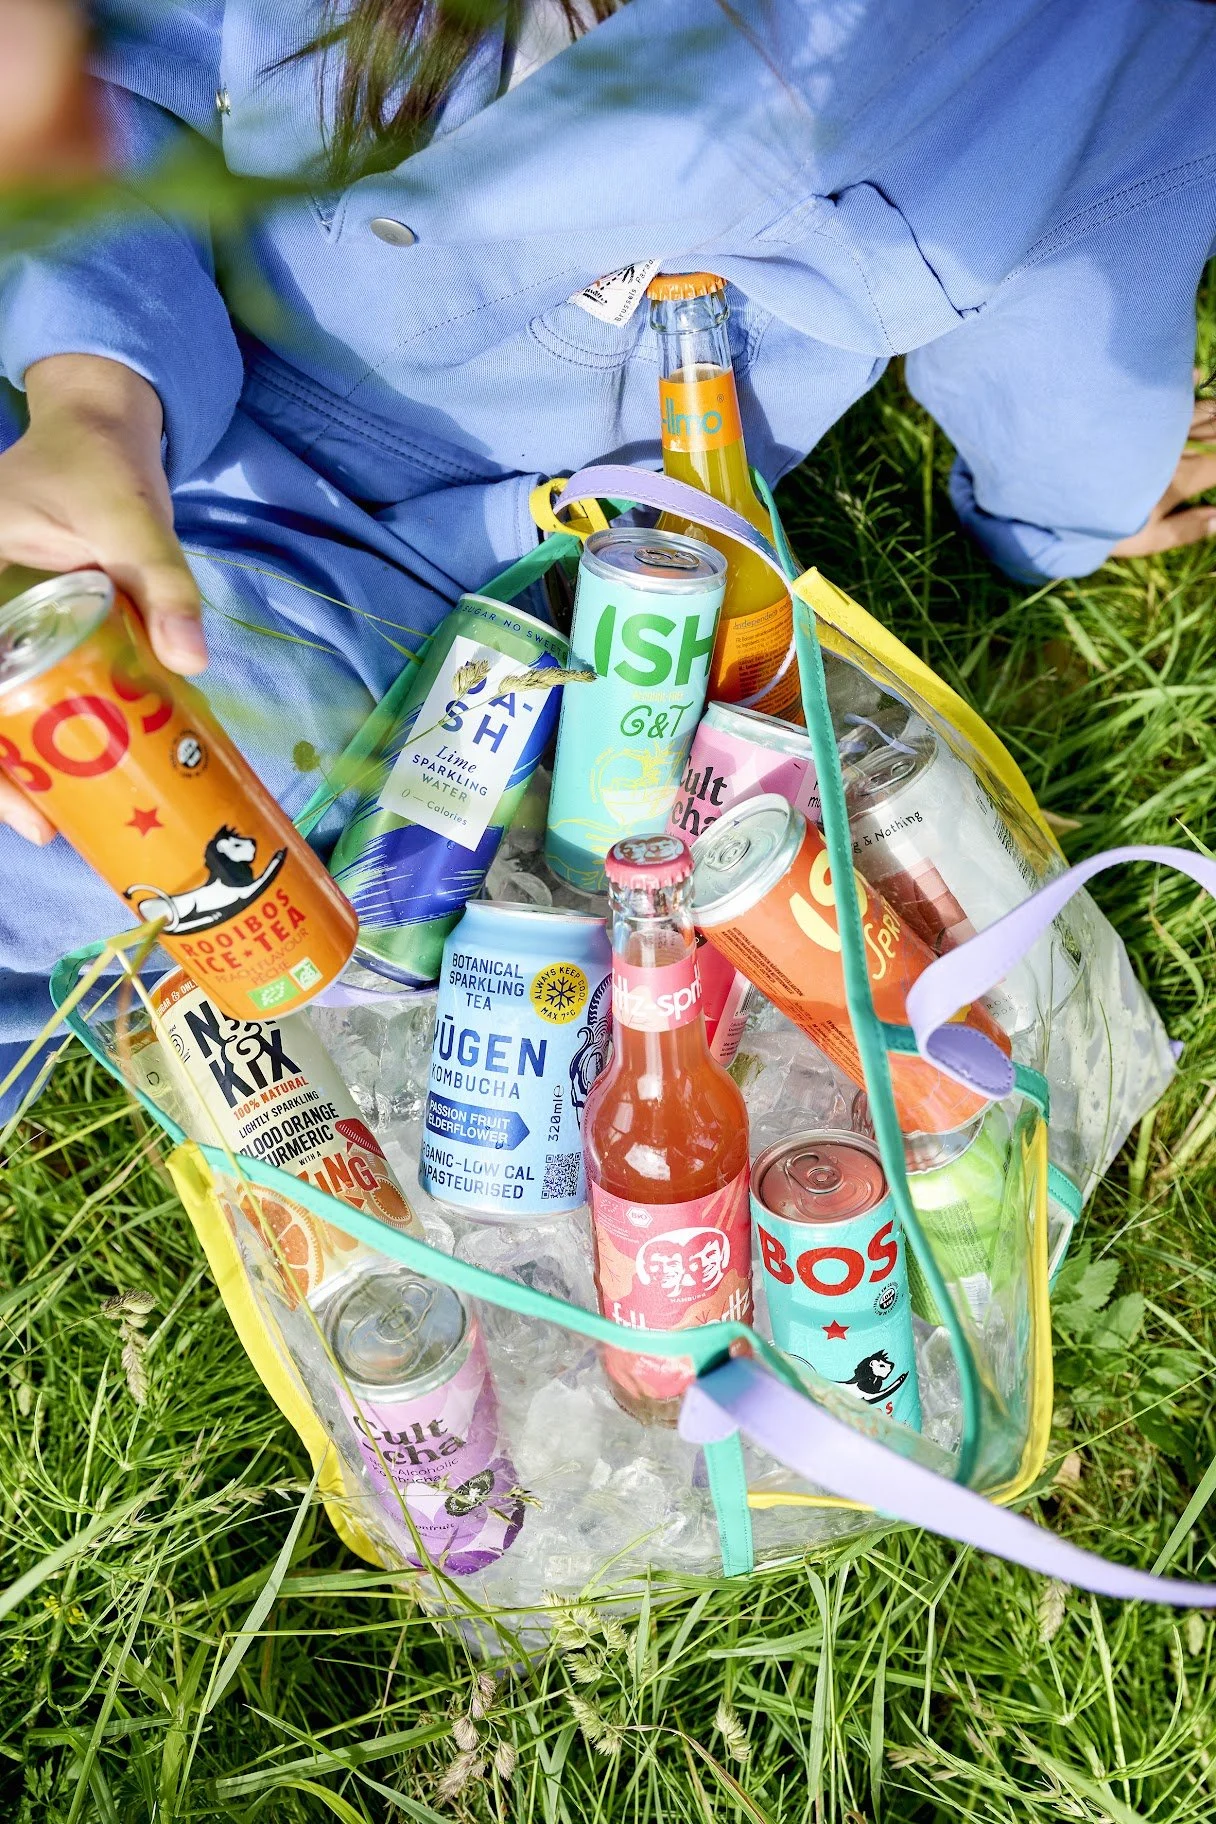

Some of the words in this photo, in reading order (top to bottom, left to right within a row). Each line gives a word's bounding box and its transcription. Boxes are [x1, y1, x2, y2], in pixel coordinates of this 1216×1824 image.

[615, 289, 637, 322] Brussels
[462, 605, 497, 621] SUGAR
[503, 620, 521, 632] NO
[594, 604, 720, 688] ISH
[440, 700, 509, 753] SH
[620, 701, 694, 739] G&T
[412, 754, 488, 797] SPARKLING
[435, 744, 478, 774] Lime
[422, 773, 470, 803] WATER
[680, 756, 727, 806] ult
[427, 800, 468, 826] Calories
[863, 836, 872, 846] &
[874, 811, 923, 842] Nothing
[180, 888, 290, 957] ROOIBOS
[193, 951, 242, 975] ICE
[253, 906, 306, 953] TEA
[452, 952, 524, 979] BOTANICAL
[449, 971, 525, 997] SPARKLING
[466, 992, 492, 1011] TEA
[534, 968, 557, 1000] ALWAYS
[559, 966, 581, 979] KEEP
[577, 979, 586, 1002] COOL
[540, 1007, 558, 1020] MAX
[209, 1028, 302, 1108] KIX
[431, 1062, 520, 1100] KOMBUCHA
[233, 1099, 261, 1121] 100%
[260, 1075, 310, 1105] NATURAL
[238, 1112, 270, 1139] LIGHTLY
[271, 1090, 320, 1117] SPARKLING
[430, 1099, 467, 1122] PASSION
[470, 1113, 511, 1130] FRUIT
[281, 1102, 340, 1138] ORANGE
[428, 1112, 509, 1143] ELDERFLOWER
[298, 1152, 316, 1166] WITH
[316, 1150, 322, 1158] A
[504, 1165, 535, 1181] CAL
[420, 1162, 524, 1199] NPASTEURISED
[757, 1220, 899, 1297] BOS
[353, 1415, 450, 1446] Cult
